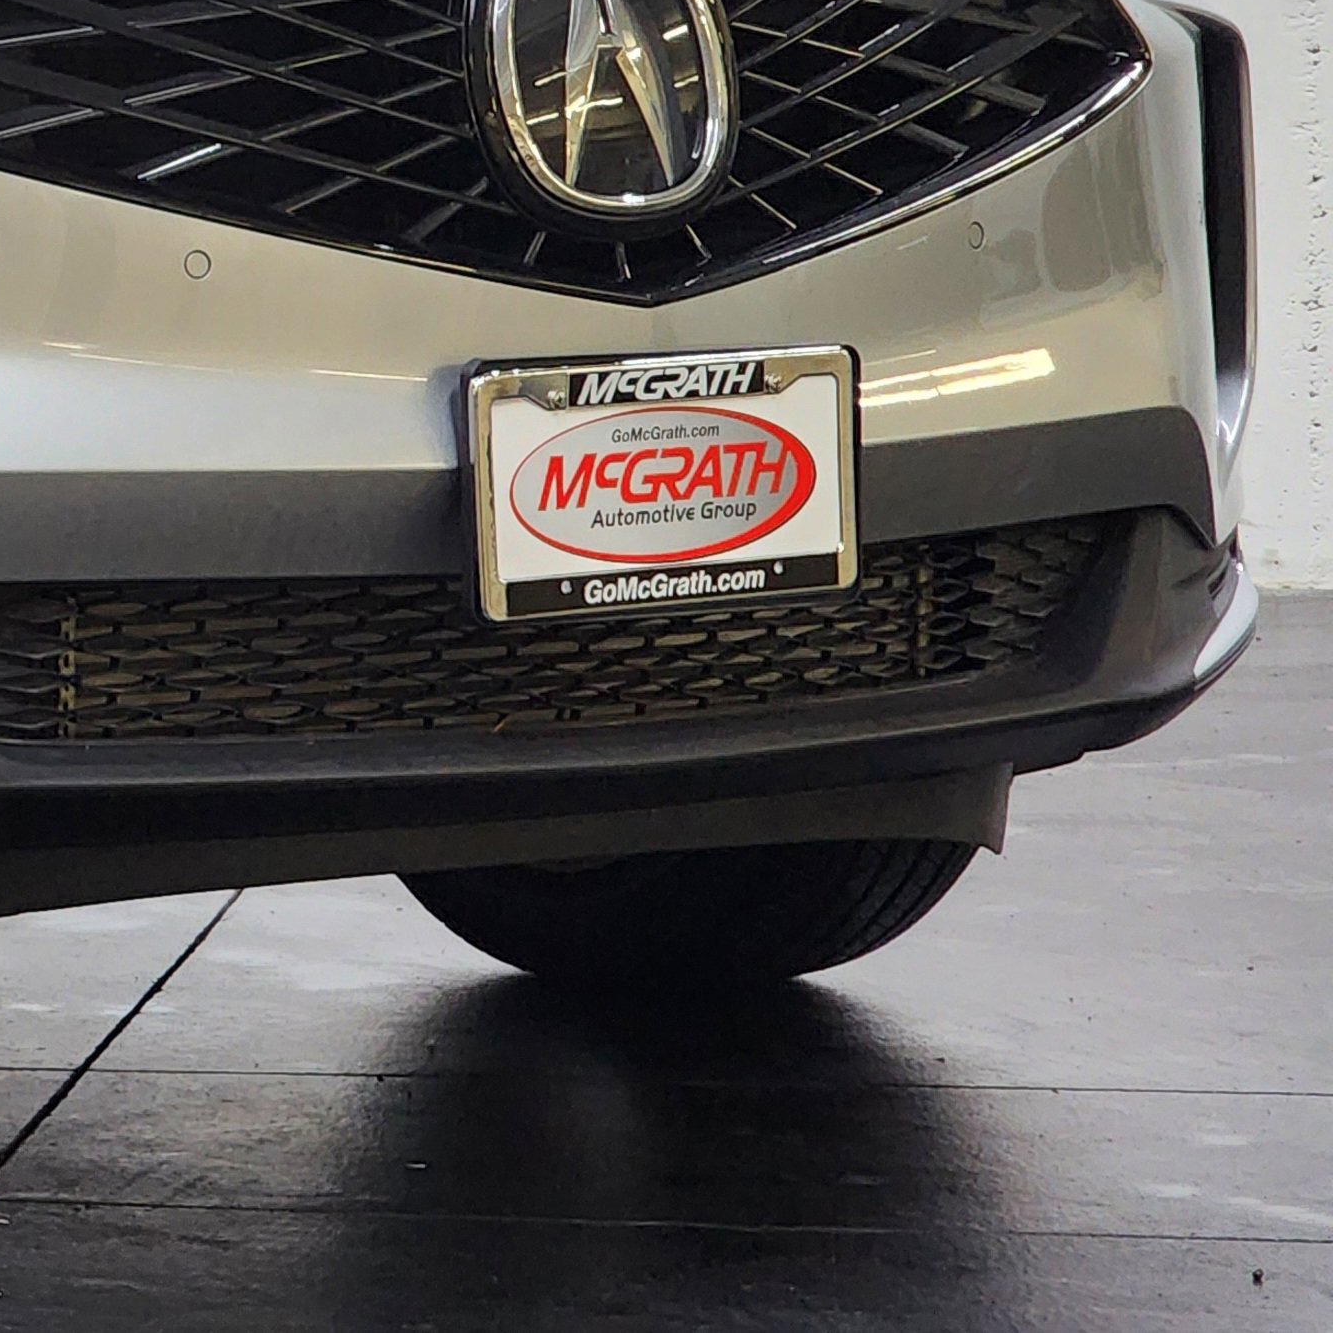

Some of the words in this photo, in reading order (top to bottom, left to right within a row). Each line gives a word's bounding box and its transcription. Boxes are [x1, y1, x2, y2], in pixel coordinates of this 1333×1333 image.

[611, 423, 720, 443] GoMcGrath.com
[591, 506, 696, 529] Automotive
[700, 502, 757, 523] Group
[584, 568, 766, 605] GoMcGrath.com
